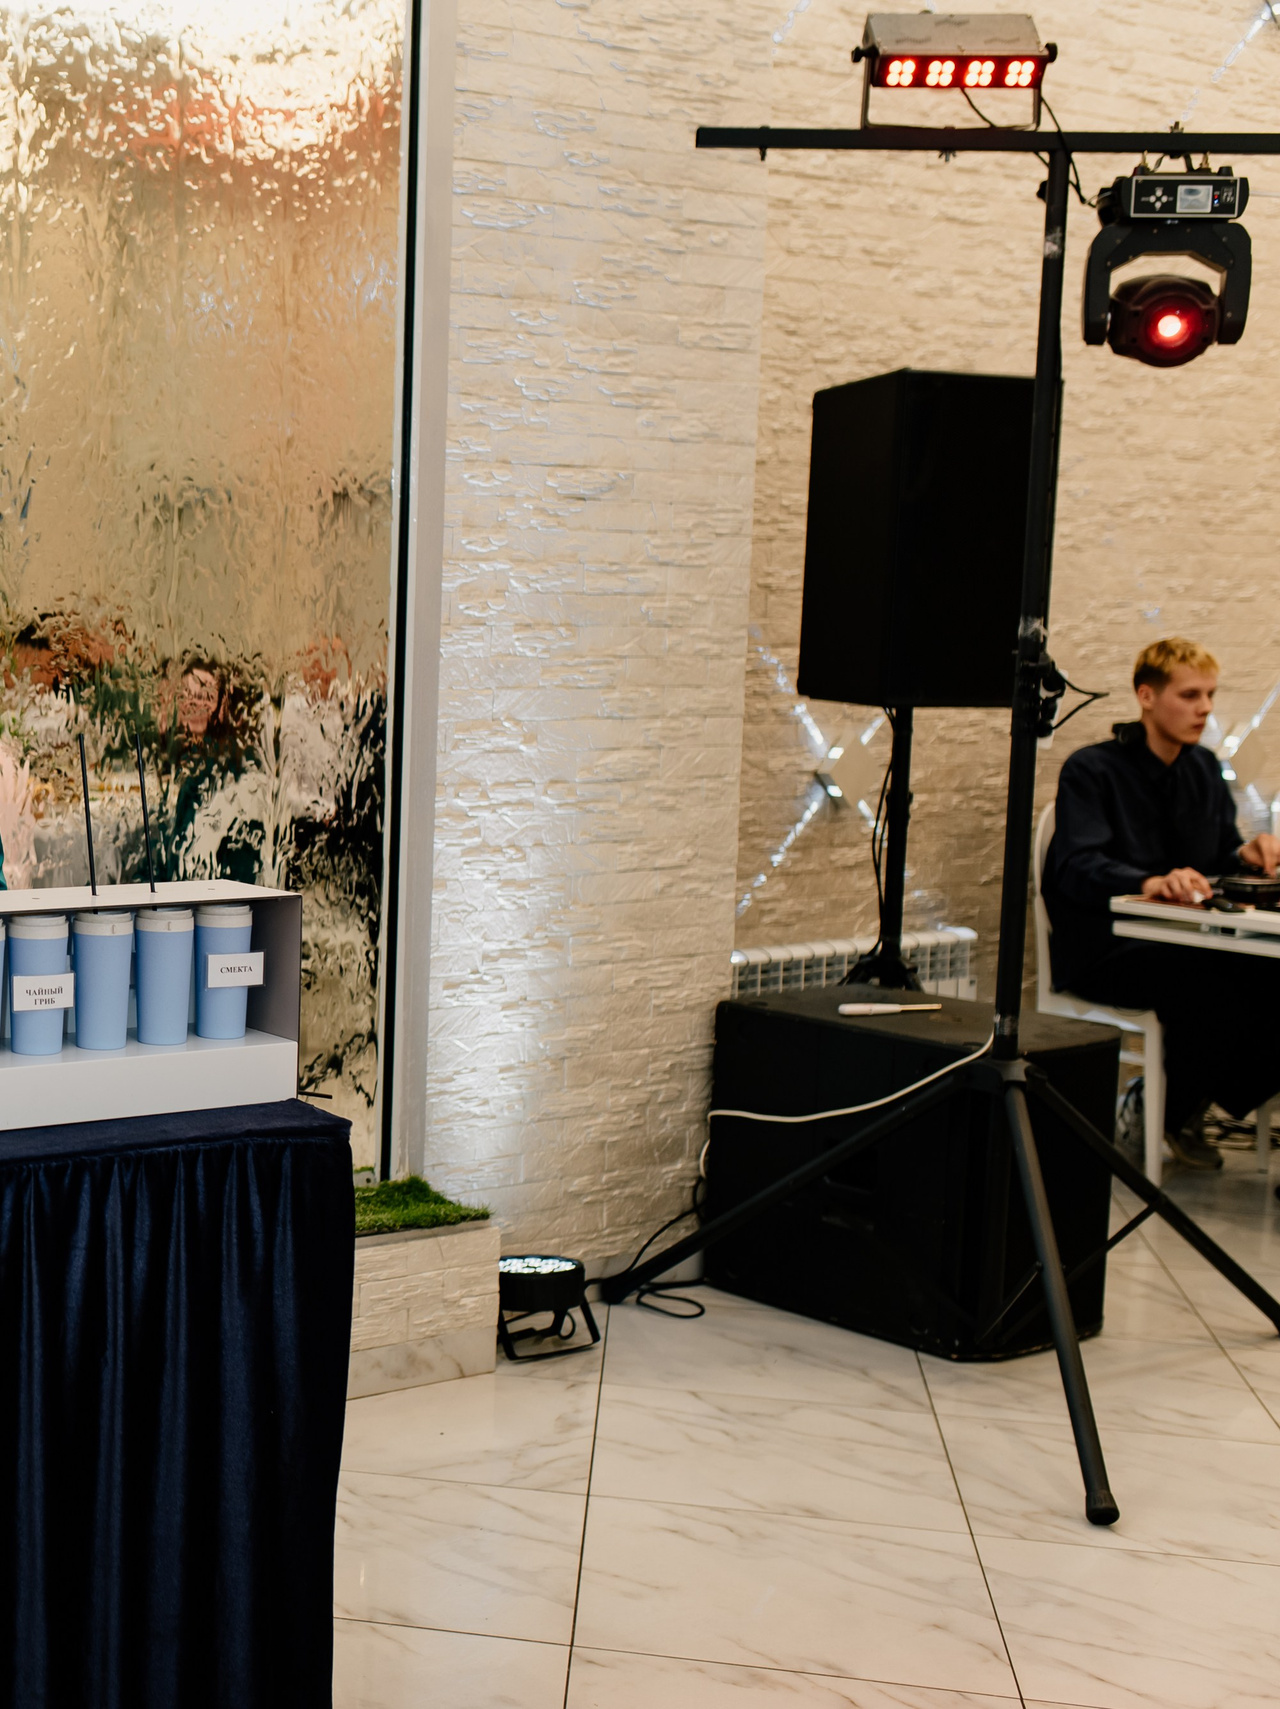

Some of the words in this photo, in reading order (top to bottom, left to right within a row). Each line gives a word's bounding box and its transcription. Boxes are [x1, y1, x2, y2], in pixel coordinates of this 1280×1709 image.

[220, 965, 253, 974] СМЕКТА
[25, 986, 63, 996] ЧАЙНЫЙ
[34, 997, 56, 1006] ГРИБ
